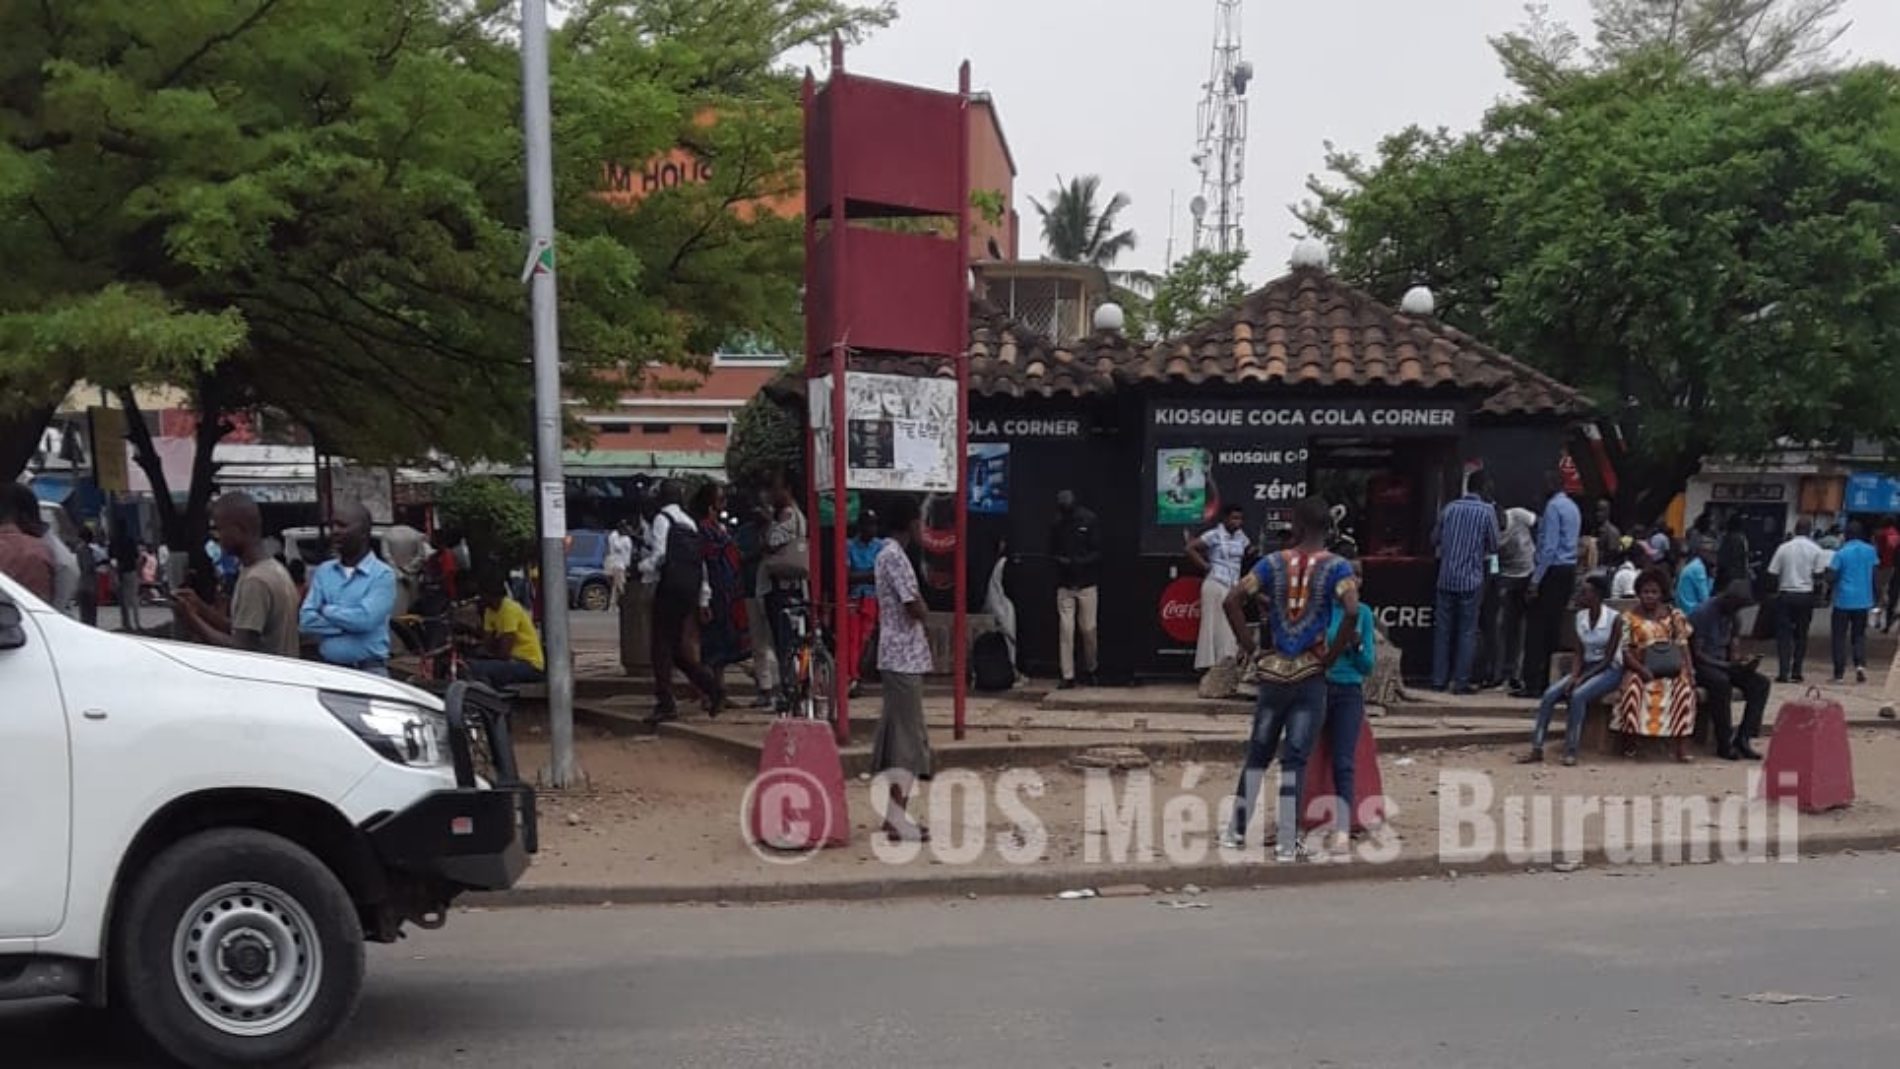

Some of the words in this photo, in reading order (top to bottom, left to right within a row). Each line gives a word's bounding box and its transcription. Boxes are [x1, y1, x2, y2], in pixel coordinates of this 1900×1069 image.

[1155, 408, 1243, 425] KIOSQUE
[1247, 408, 1306, 426] COCA
[1310, 408, 1366, 426] COLA
[1371, 408, 1455, 426] CORNER
[1003, 419, 1079, 436] CORNER
[1219, 451, 1281, 464] KIOSQUE
